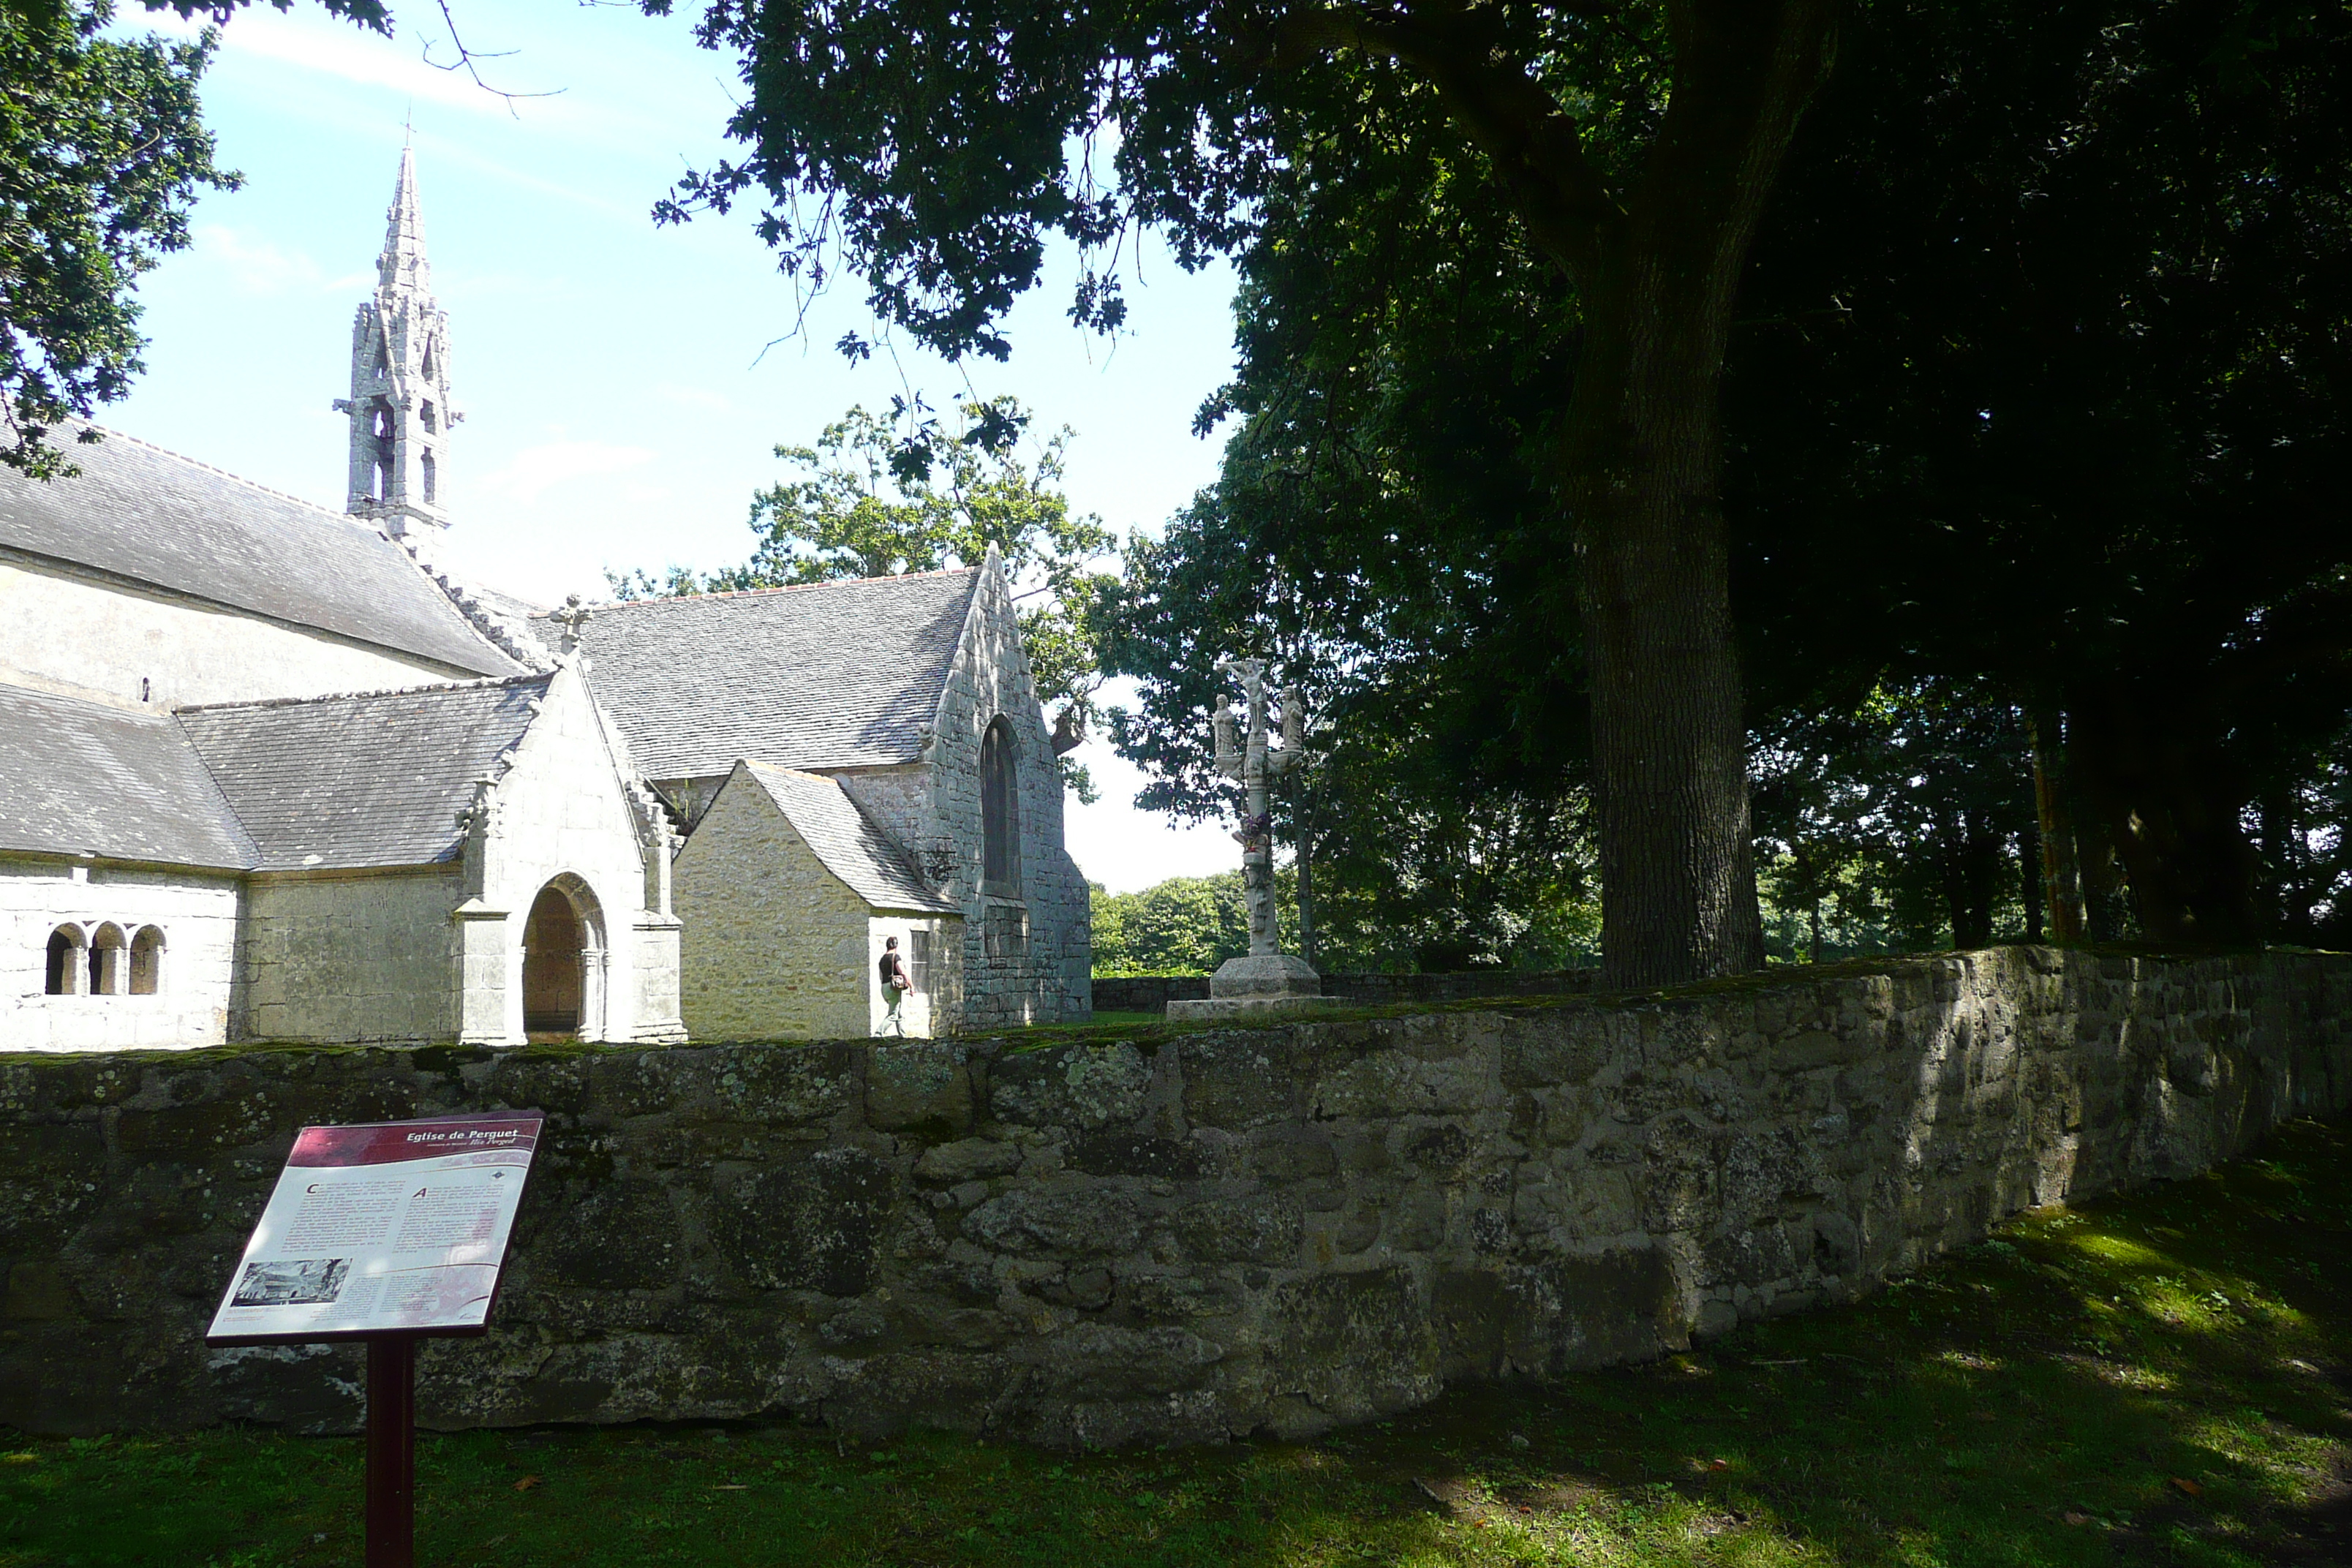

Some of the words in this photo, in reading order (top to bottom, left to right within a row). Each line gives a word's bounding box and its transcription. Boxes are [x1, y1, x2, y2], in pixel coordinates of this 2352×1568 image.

[407, 1132, 445, 1142] Eglise
[449, 1131, 465, 1139] de
[469, 1129, 519, 1139] Perguet
